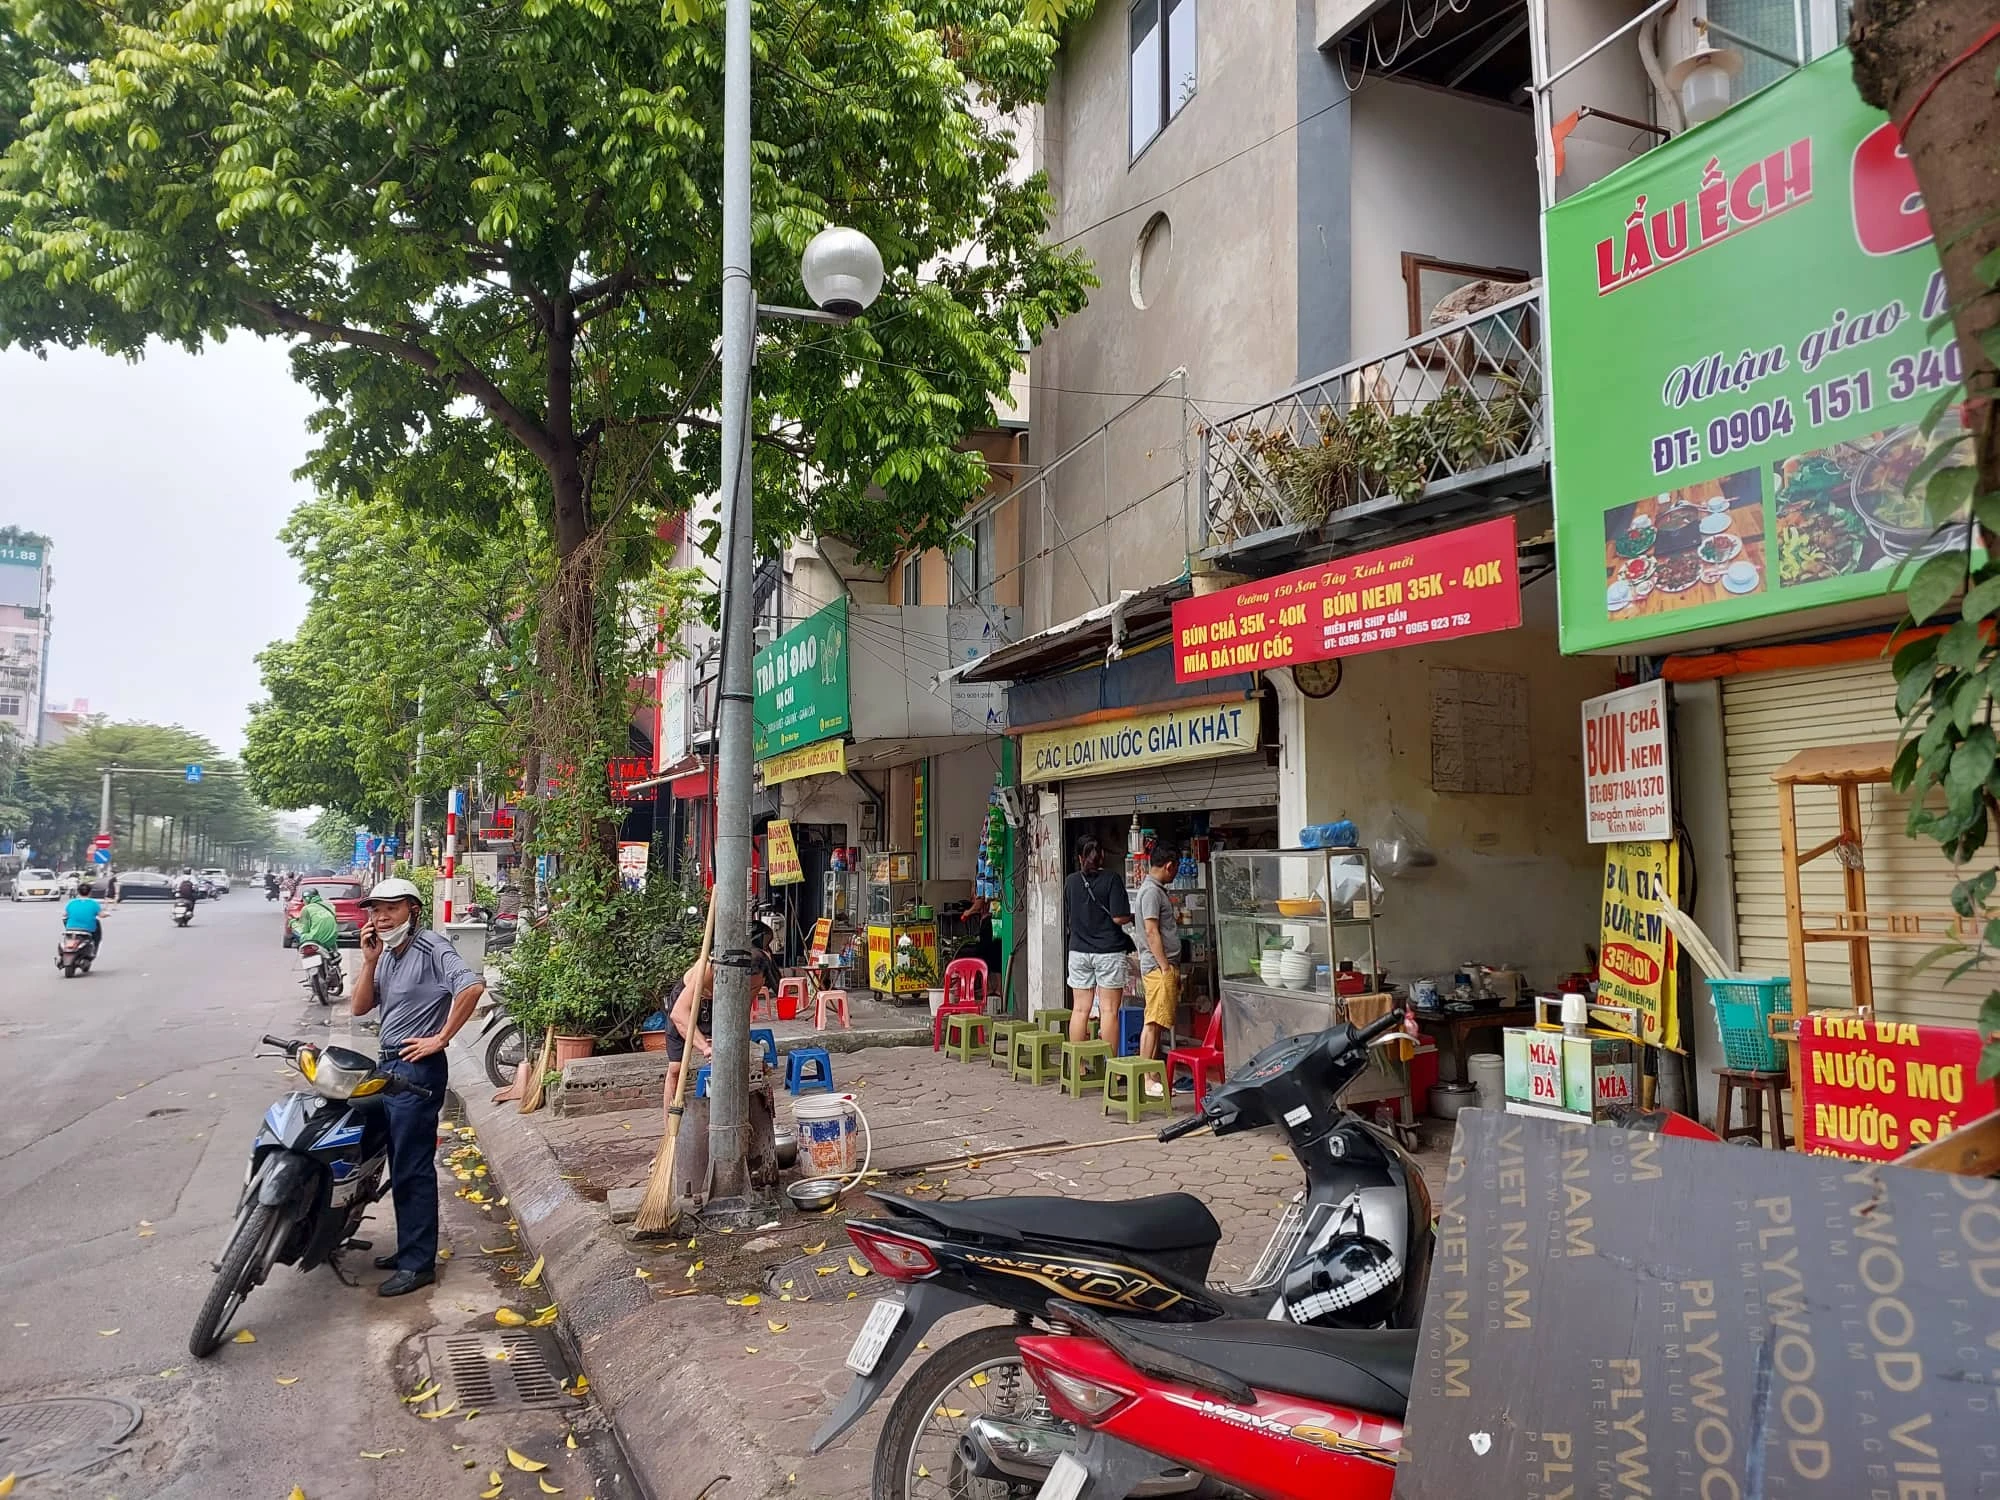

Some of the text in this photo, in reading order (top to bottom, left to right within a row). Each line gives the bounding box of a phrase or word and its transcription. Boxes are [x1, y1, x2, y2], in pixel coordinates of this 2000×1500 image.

[1594, 195, 1688, 289] LẨU
[1698, 137, 1813, 242] ẾCH
[1663, 299, 1909, 408] Nhận giao
[1652, 428, 1700, 475] ĐT:
[1707, 399, 1795, 459] 0904
[1806, 370, 1874, 429] 151
[1274, 584, 1293, 598] 150
[1322, 591, 1357, 619] BÚN
[1362, 582, 1403, 611] NEM
[1407, 573, 1444, 601] 35K
[1463, 560, 1502, 589] 40K
[1364, 614, 1385, 628] SHIP
[1182, 624, 1208, 648] BÚN
[1210, 613, 1237, 642] CHẢ
[1240, 612, 1266, 636] 35K
[1278, 603, 1307, 627] 40K
[1183, 650, 1209, 674] MÍA
[1263, 631, 1293, 659] CỐC
[756, 635, 816, 697] TRÀ BÍ ĐAO
[1036, 742, 1061, 770] CÁC
[1100, 725, 1142, 761] NƯỚC
[1148, 713, 1182, 753] GIẢI
[1188, 704, 1242, 745] KHÁT
[1586, 703, 1626, 777] BÚN
[1529, 1039, 1558, 1066] MÍA
[1598, 1070, 1629, 1098] MÍA
[1812, 1049, 1963, 1104] NƯỚC MƠ
[1533, 1071, 1556, 1099] ĐÁ
[1815, 1103, 1966, 1150] NƯỚC SẤ
[1498, 1125, 1532, 1329] VIET NAM
[1562, 1148, 1595, 1256] NAM
[1441, 1195, 1468, 1277] VIET
[1443, 1290, 1471, 1397] NAM
[1754, 1196, 1831, 1480] PLYWOOD
[1609, 1359, 1652, 1500] PLYW
